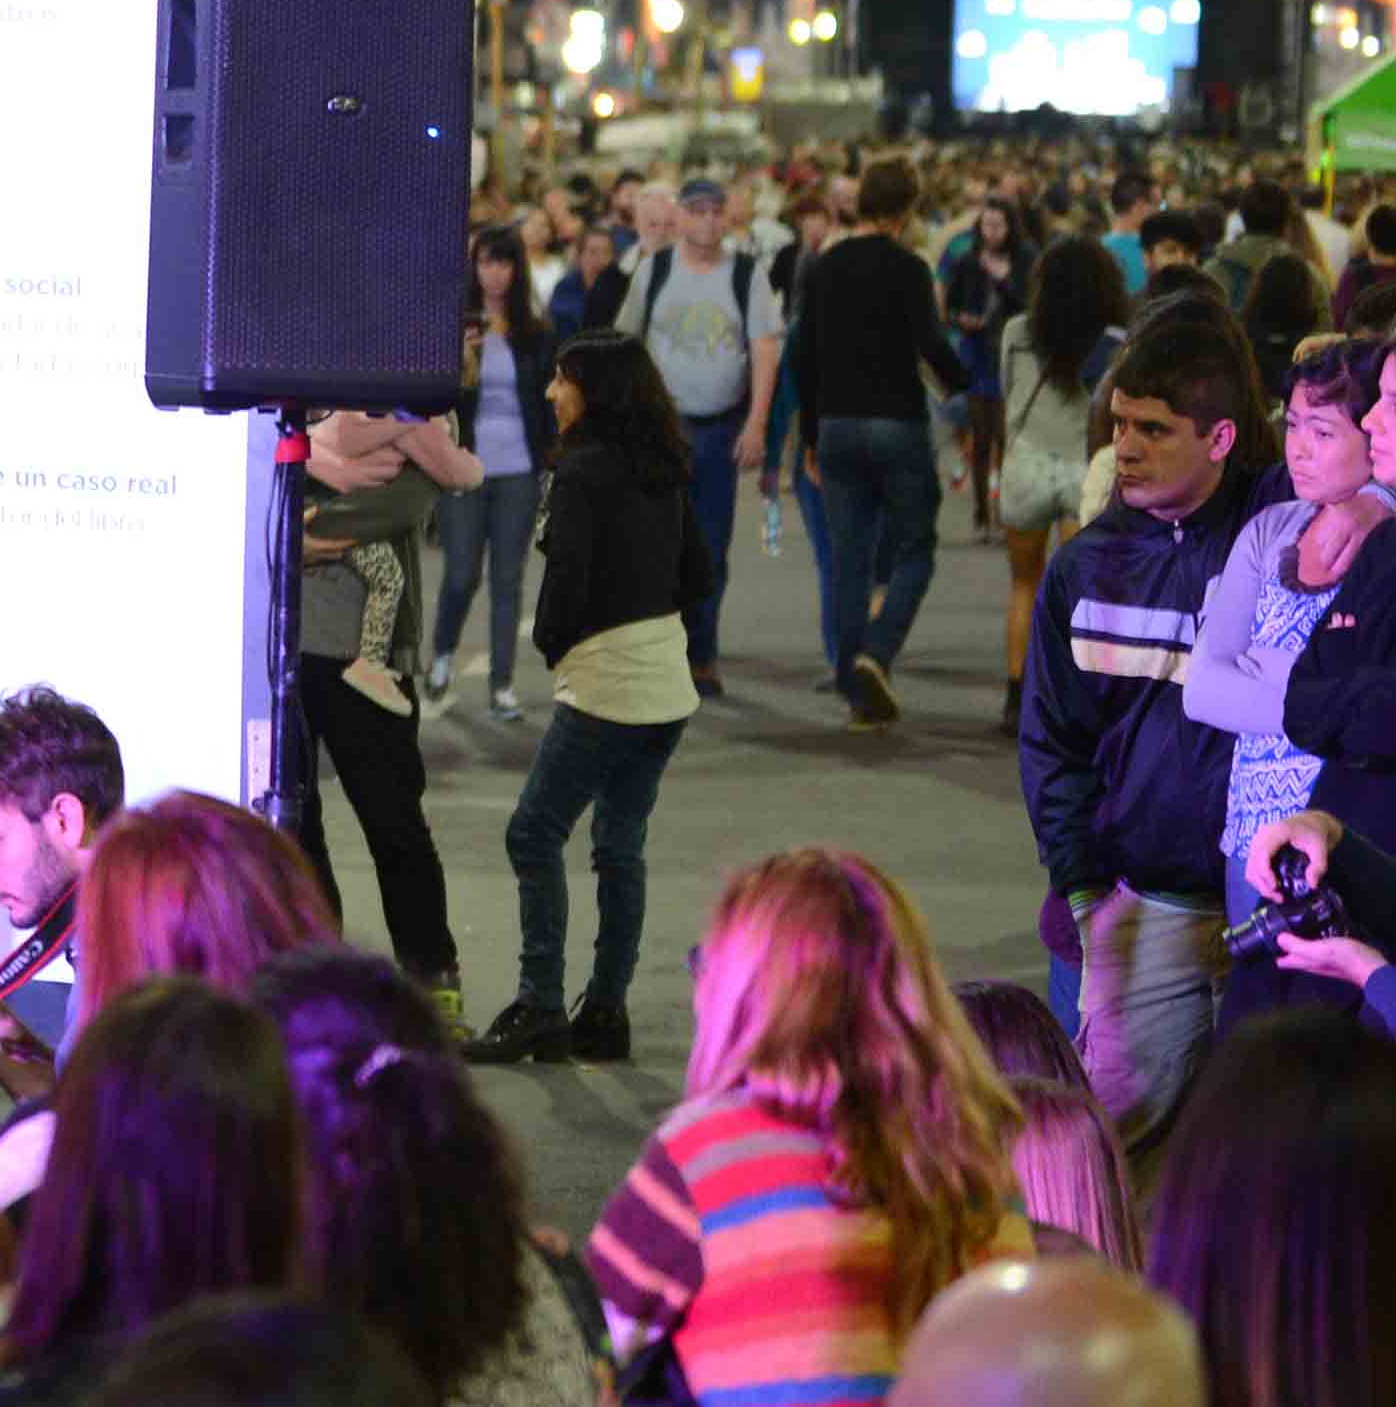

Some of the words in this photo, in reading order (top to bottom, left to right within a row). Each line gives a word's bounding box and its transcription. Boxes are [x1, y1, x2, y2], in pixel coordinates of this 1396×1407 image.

[4, 274, 83, 297] social
[16, 468, 48, 489] un
[57, 474, 118, 494] caso
[127, 472, 177, 496] real
